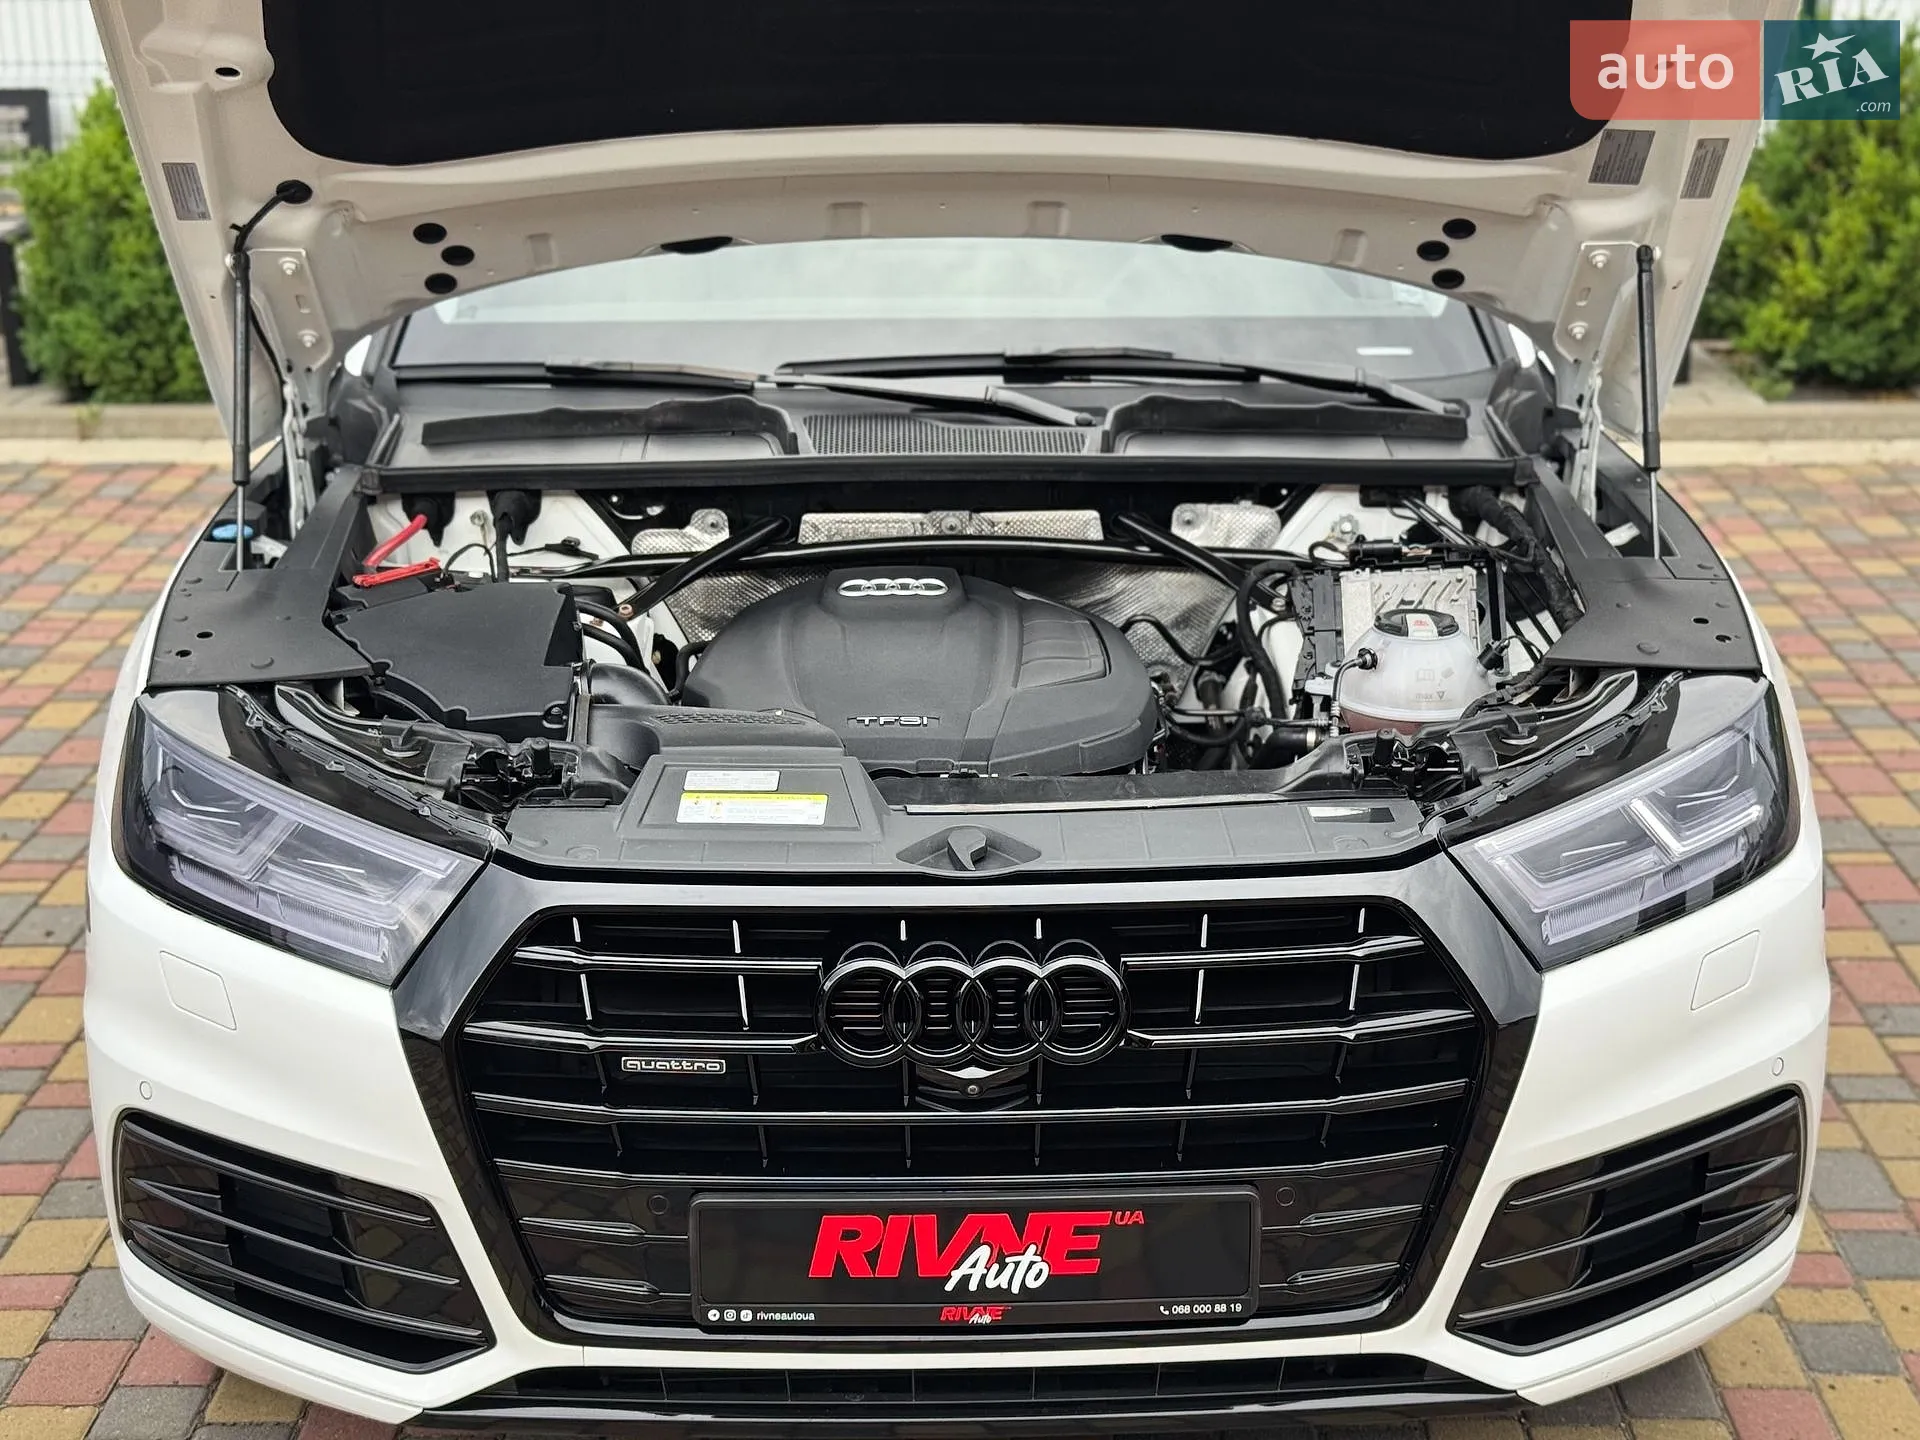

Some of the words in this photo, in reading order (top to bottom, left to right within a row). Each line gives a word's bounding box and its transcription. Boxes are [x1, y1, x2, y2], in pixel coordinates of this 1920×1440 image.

[856, 716, 929, 727] TFSI
[626, 1060, 721, 1071] quattro
[808, 1211, 1112, 1278] RIVNE
[1114, 1211, 1145, 1225] UA
[943, 1244, 1050, 1295] Auto
[1171, 1304, 1191, 1315] 068
[1193, 1304, 1212, 1314] 000
[1214, 1303, 1227, 1313] 88
[1230, 1303, 1242, 1313] 19
[756, 1311, 816, 1321] rivneautoua
[968, 1312, 993, 1325] Auto
